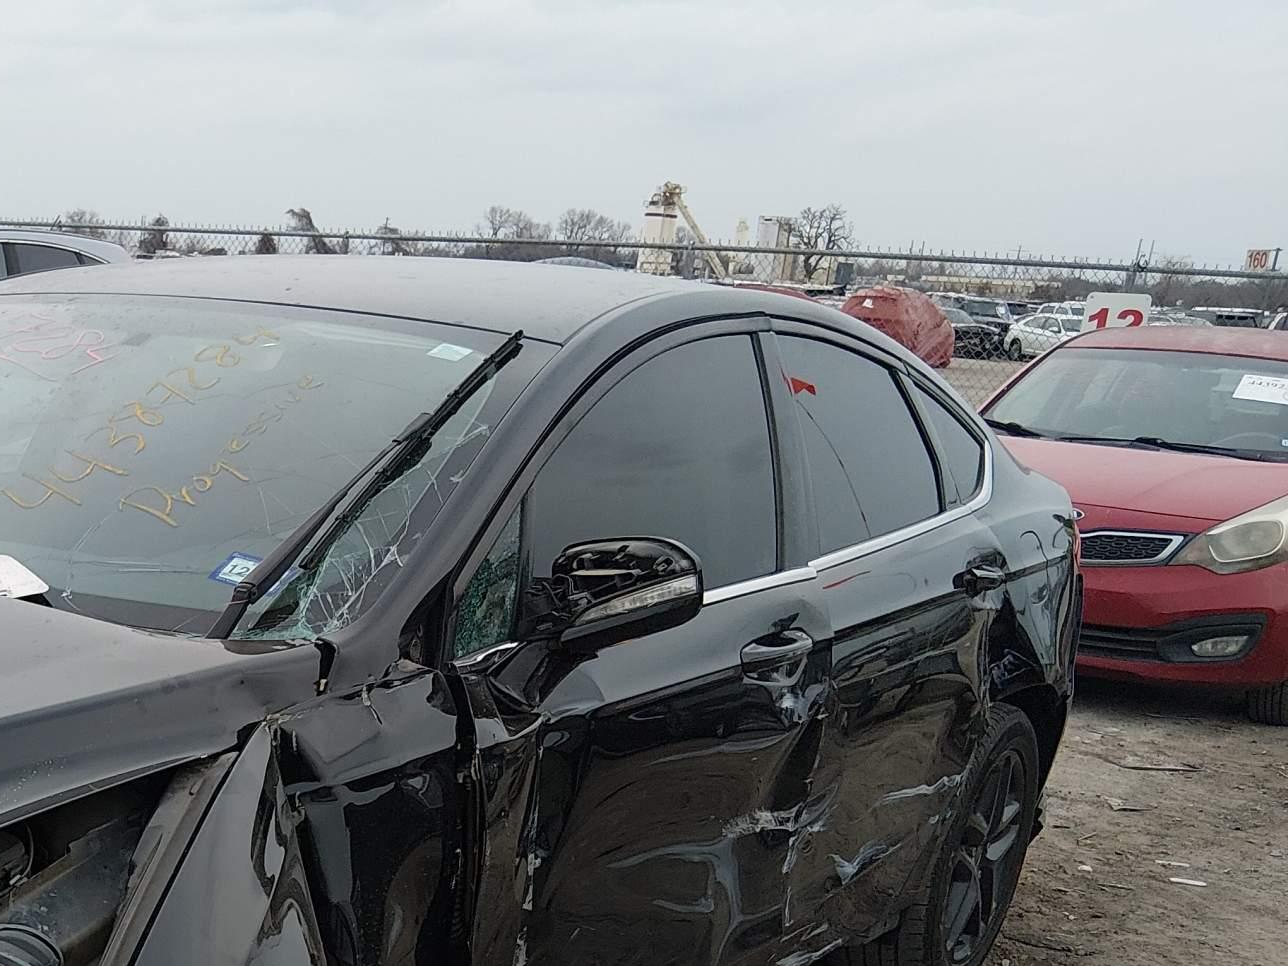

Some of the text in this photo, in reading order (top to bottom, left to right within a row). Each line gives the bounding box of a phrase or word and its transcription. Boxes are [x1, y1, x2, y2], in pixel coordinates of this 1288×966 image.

[1247, 250, 1268, 269] 160
[1088, 307, 1144, 329] 12
[228, 563, 251, 578] 12
